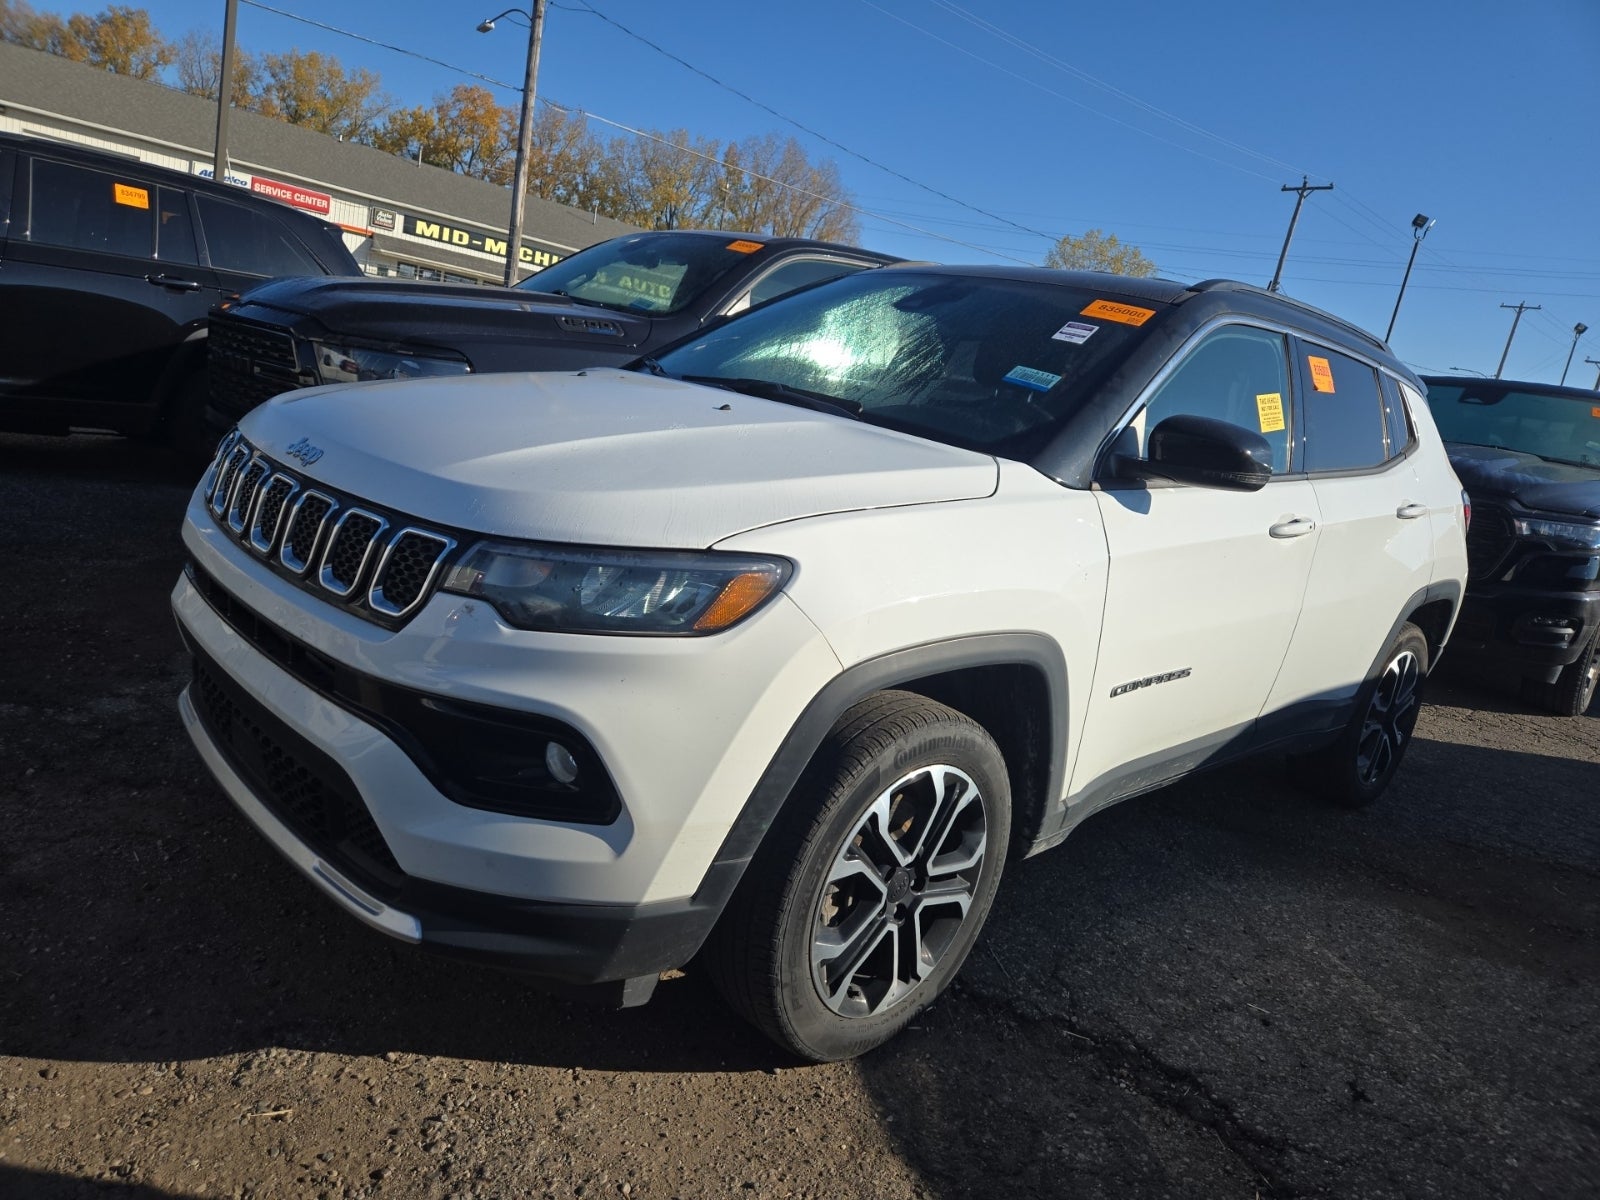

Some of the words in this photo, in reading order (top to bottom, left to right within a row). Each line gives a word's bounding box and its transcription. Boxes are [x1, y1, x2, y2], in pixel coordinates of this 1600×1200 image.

[254, 183, 292, 199] SERVICE
[294, 193, 328, 209] CENTER
[286, 437, 324, 467] Jeep
[1109, 667, 1192, 698] COMPASS
